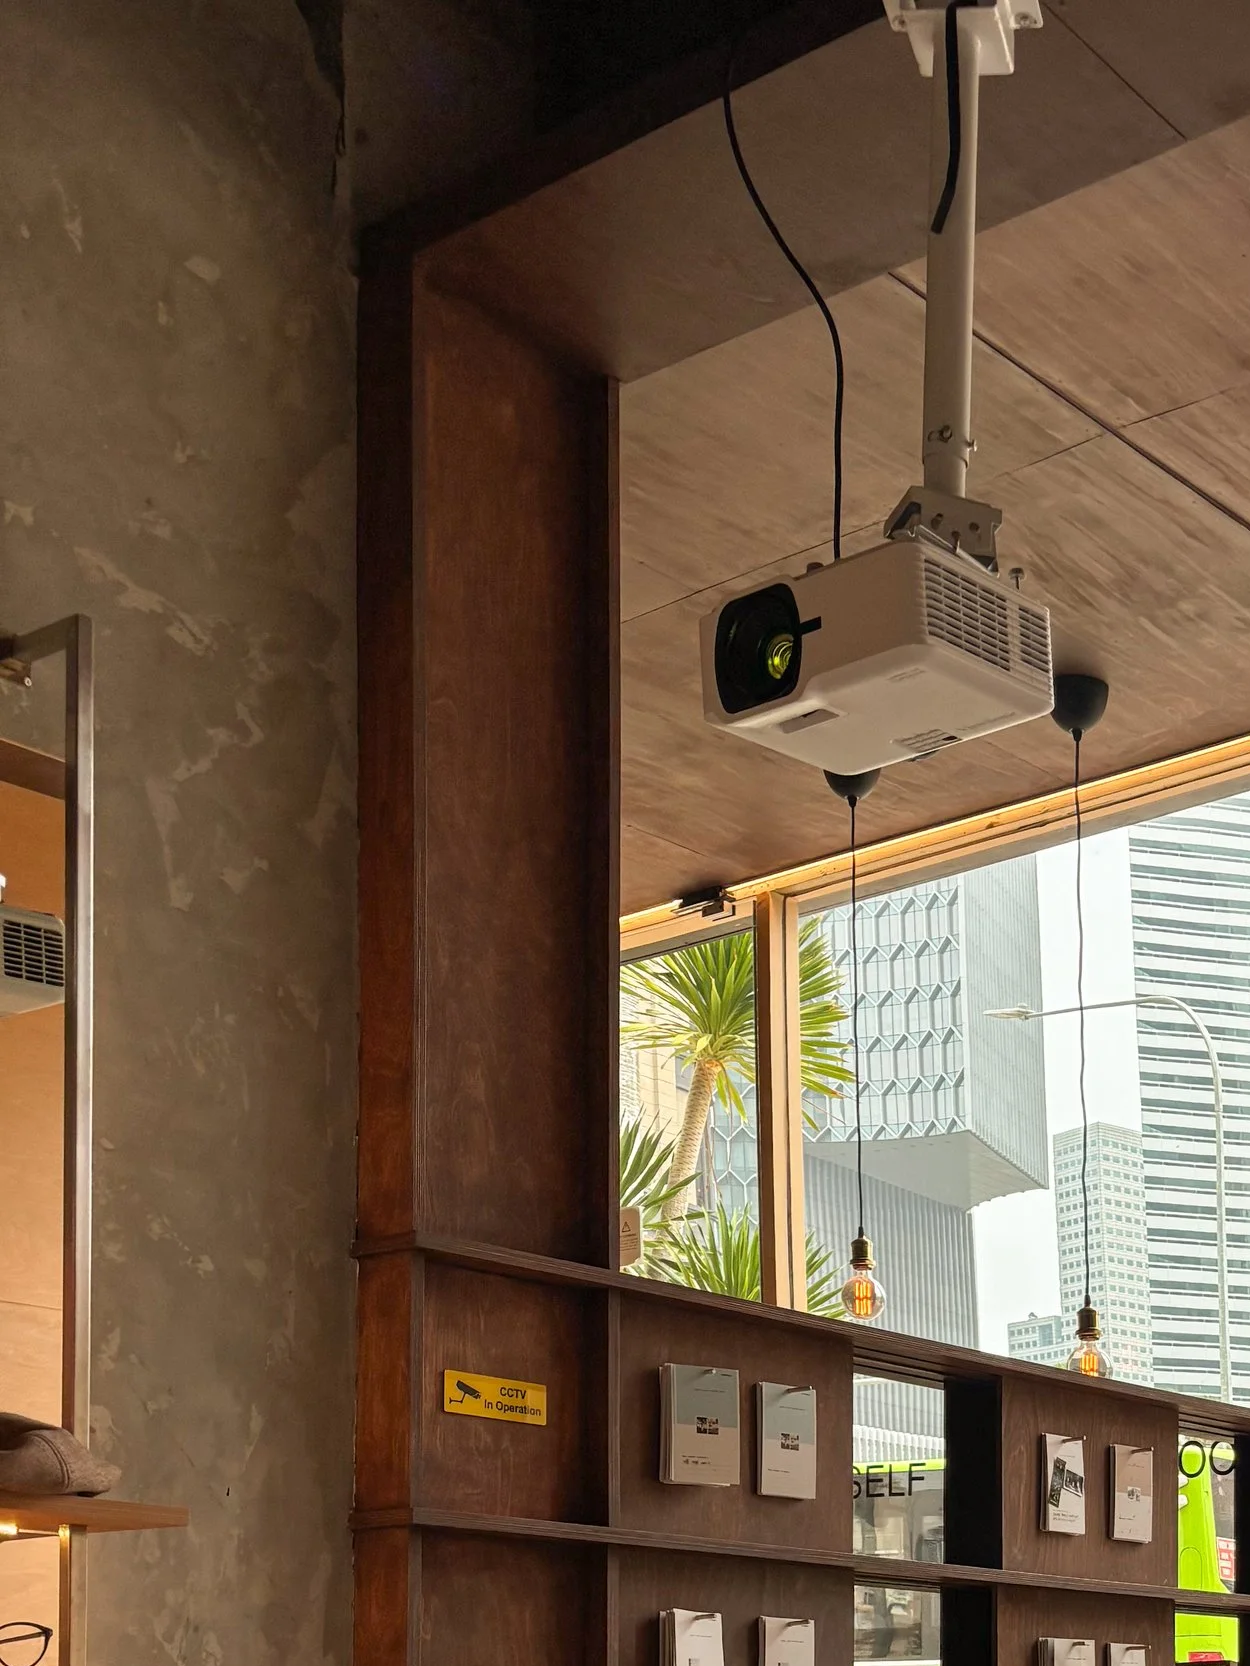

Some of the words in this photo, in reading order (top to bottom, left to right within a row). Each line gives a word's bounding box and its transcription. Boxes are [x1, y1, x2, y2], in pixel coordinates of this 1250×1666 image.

[500, 1386, 527, 1400] CCTV
[484, 1399, 493, 1410] In
[496, 1401, 542, 1417] Operation
